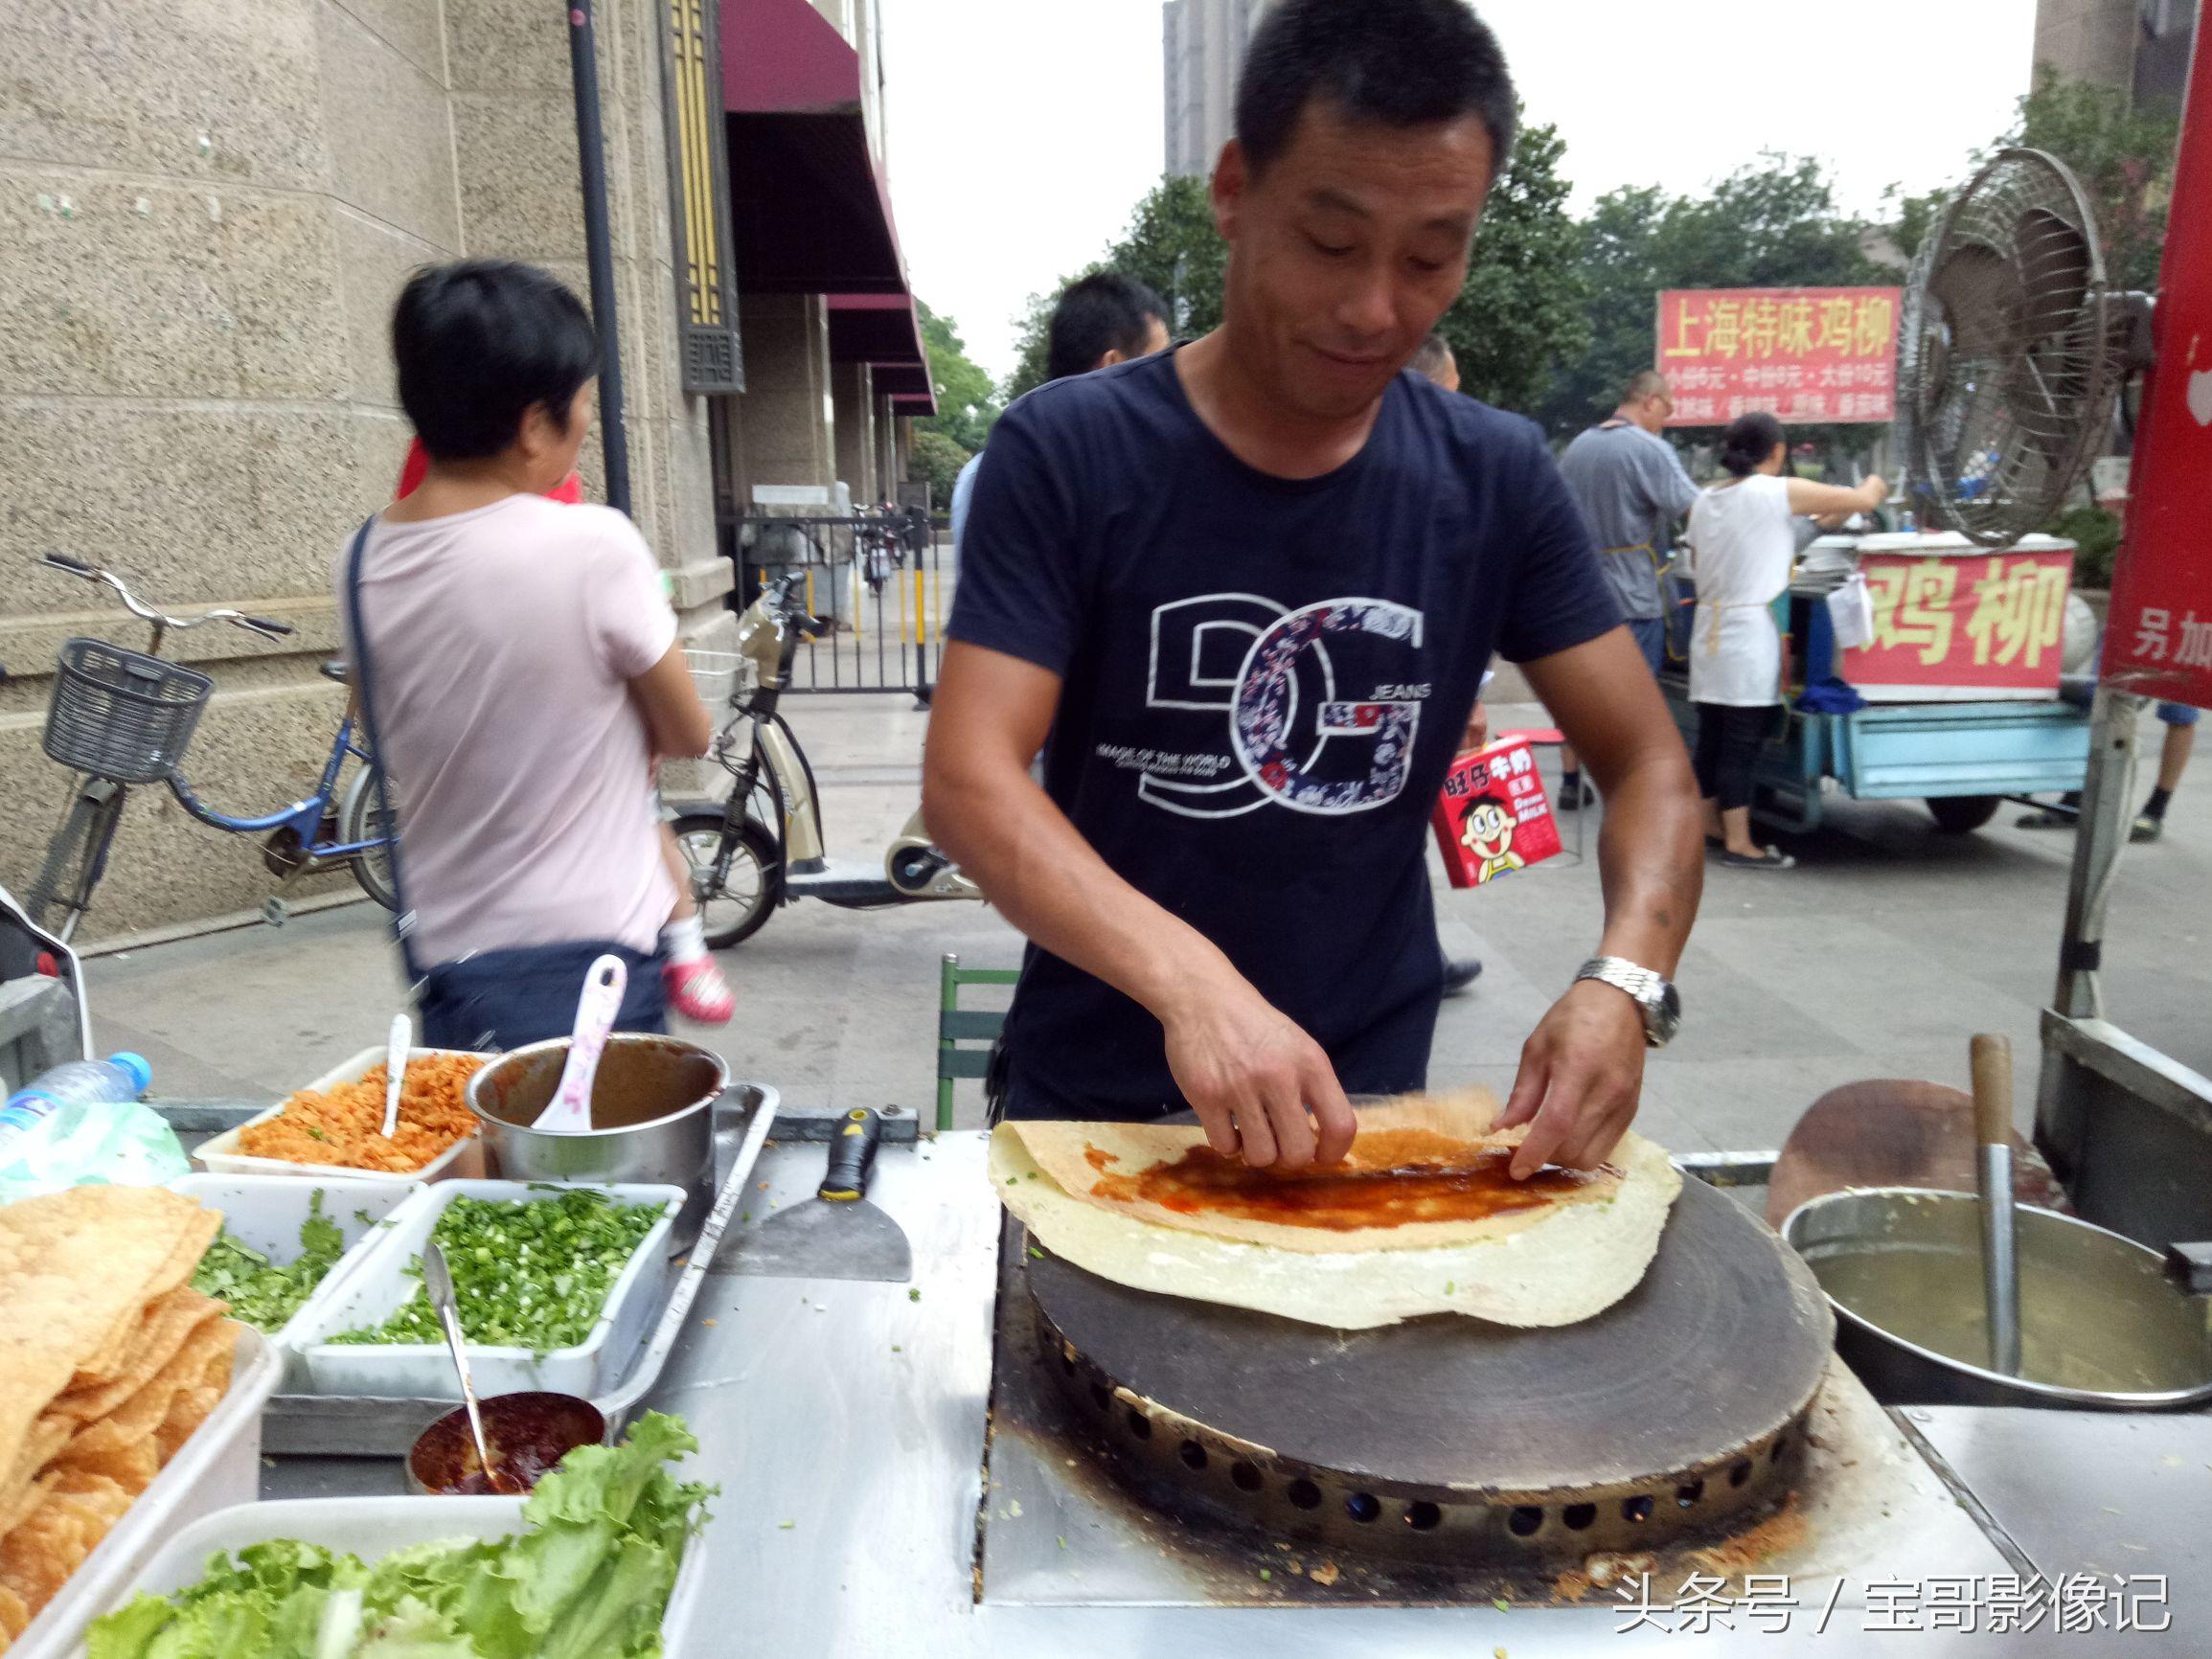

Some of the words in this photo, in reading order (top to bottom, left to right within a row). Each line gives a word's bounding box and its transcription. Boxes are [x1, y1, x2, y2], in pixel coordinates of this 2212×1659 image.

[1665, 296, 1892, 358] 上海特味鸡柳
[1859, 557, 2067, 668] 鸡柳
[1368, 682, 1432, 701] JEANS
